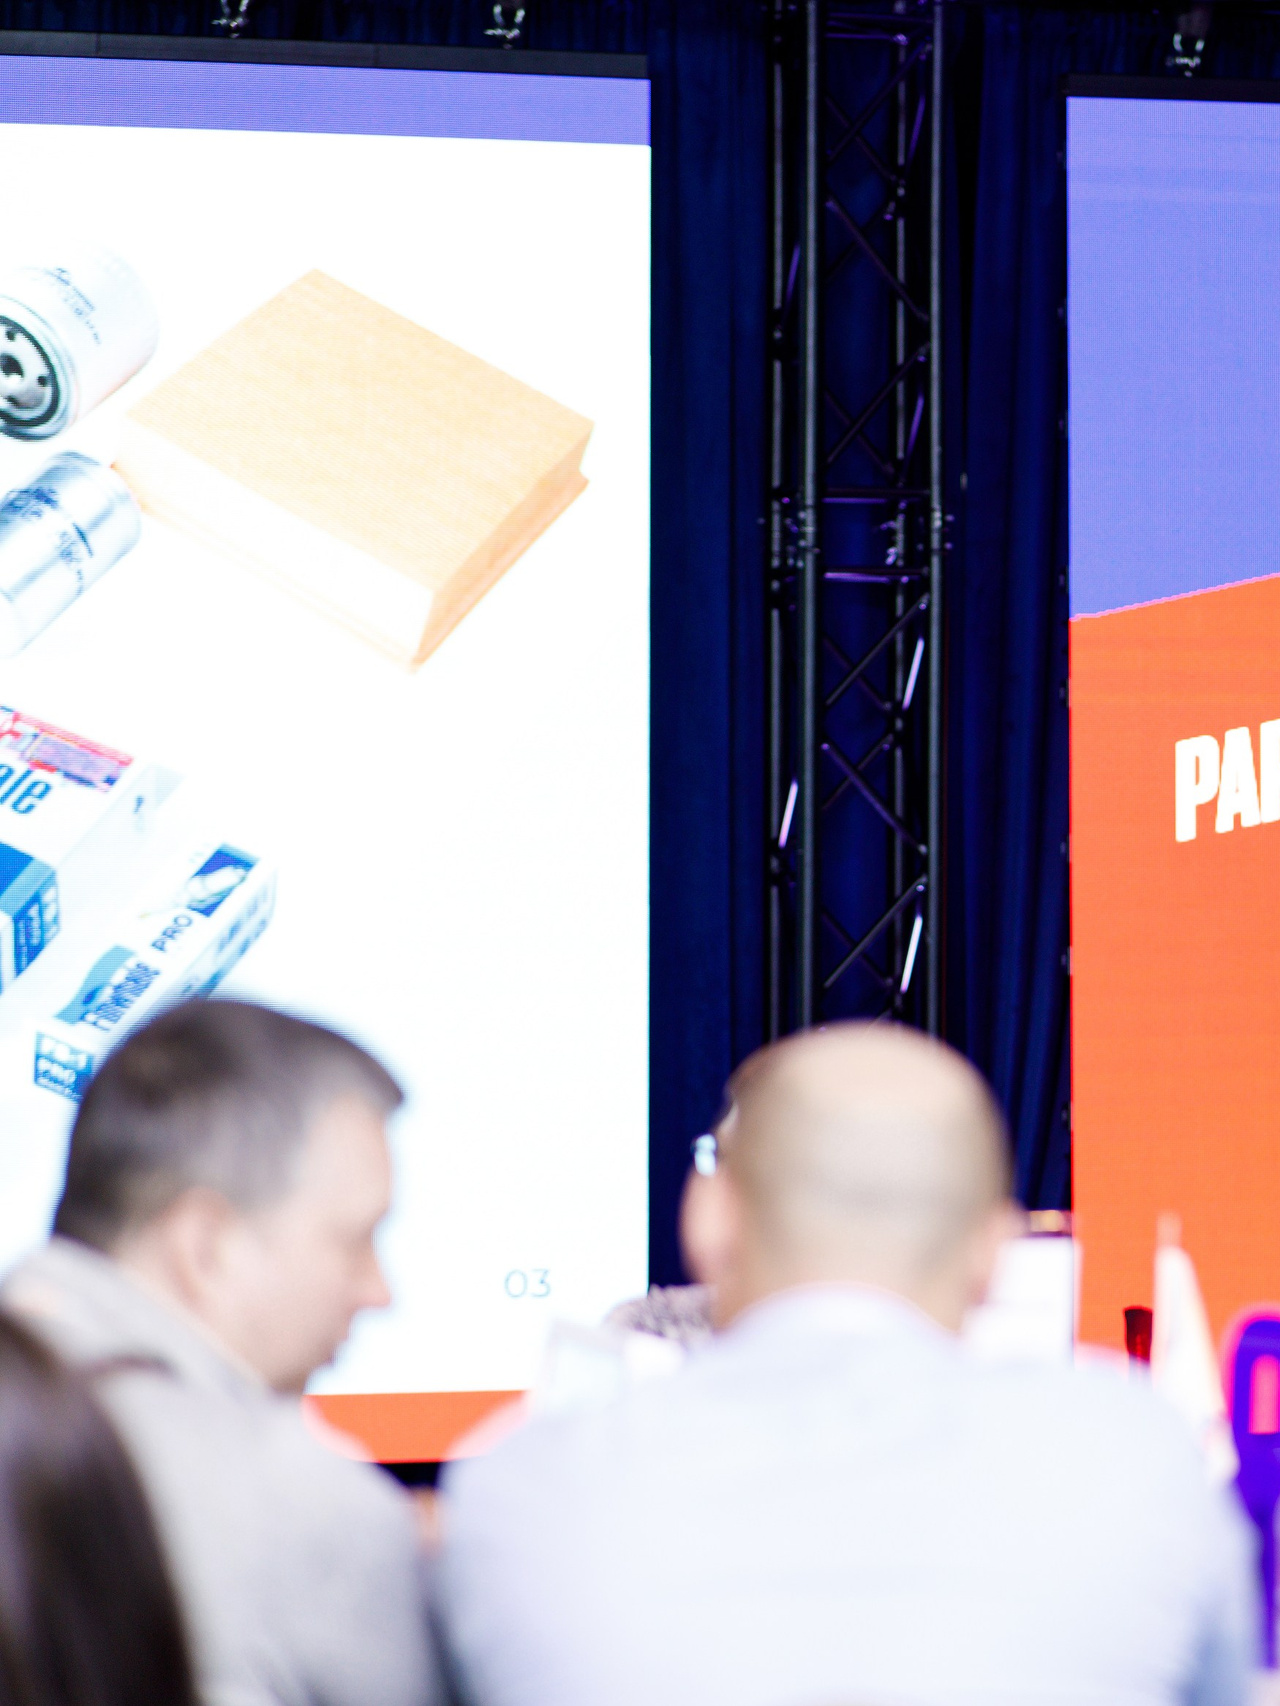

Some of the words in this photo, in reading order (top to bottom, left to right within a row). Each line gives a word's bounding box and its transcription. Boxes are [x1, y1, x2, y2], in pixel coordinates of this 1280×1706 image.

[0, 763, 52, 814] le
[151, 915, 193, 953] PRO
[504, 1268, 552, 1299] 03
